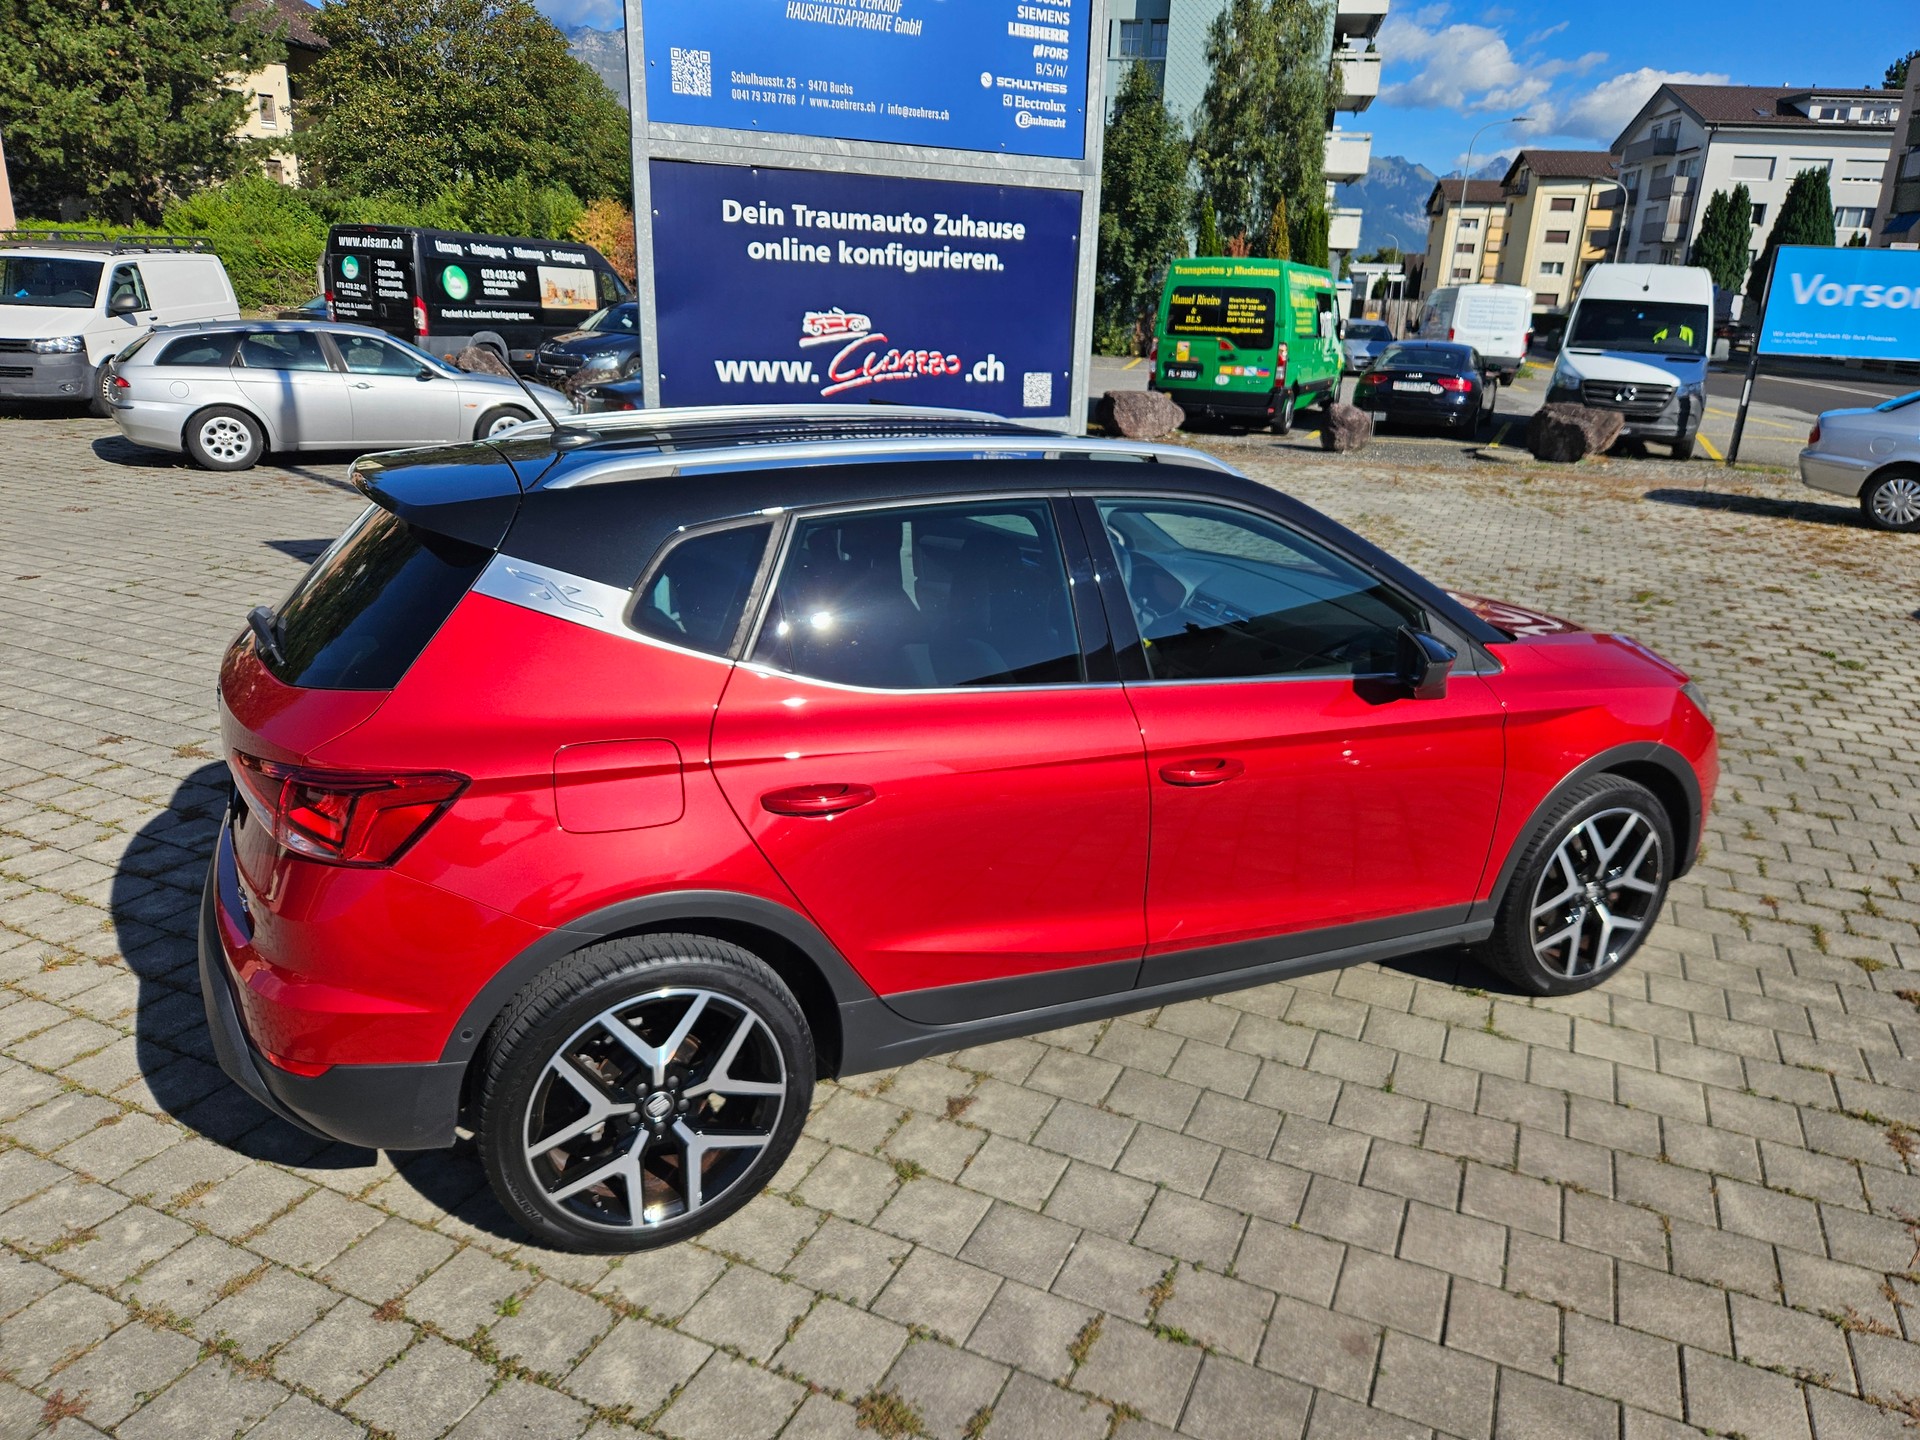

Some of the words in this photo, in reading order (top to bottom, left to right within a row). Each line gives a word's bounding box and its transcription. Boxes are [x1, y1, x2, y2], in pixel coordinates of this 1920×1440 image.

[786, 1, 892, 32] HAUSHALTSAPPARATE
[894, 16, 923, 36] GmbH
[1017, 5, 1070, 25] SIEMENS
[1008, 21, 1069, 43] LIEBHERR
[1044, 46, 1069, 60] FORS
[1036, 62, 1068, 78] B/S/H/
[731, 71, 785, 88] Schulhausstr.
[786, 77, 796, 89] 25
[808, 80, 828, 93] 9470
[830, 82, 853, 95] Buchs
[996, 76, 1068, 94] SCHULTHESS
[731, 88, 749, 100] 0041
[751, 90, 760, 102] 79
[763, 91, 776, 103] 378
[778, 93, 796, 105] 7766
[809, 96, 876, 113] www.zoehrers.ch
[888, 103, 949, 121] info@zoehrers.ch
[1015, 94, 1066, 112] Electrolux
[1018, 112, 1066, 128] Bauknecht
[722, 199, 784, 225] Dein
[791, 203, 927, 234] Traumauto
[933, 213, 1026, 240] Zuhause
[338, 235, 403, 249] www.oisam.ch
[747, 237, 831, 263] online
[838, 240, 1004, 273] konfigurieren.
[481, 268, 495, 279] 079
[1174, 265, 1225, 276] Transportes
[1226, 267, 1233, 277] y
[1234, 265, 1280, 277] Mudanzas
[1171, 293, 1196, 304] Manuel
[1196, 293, 1221, 306] Riveiro
